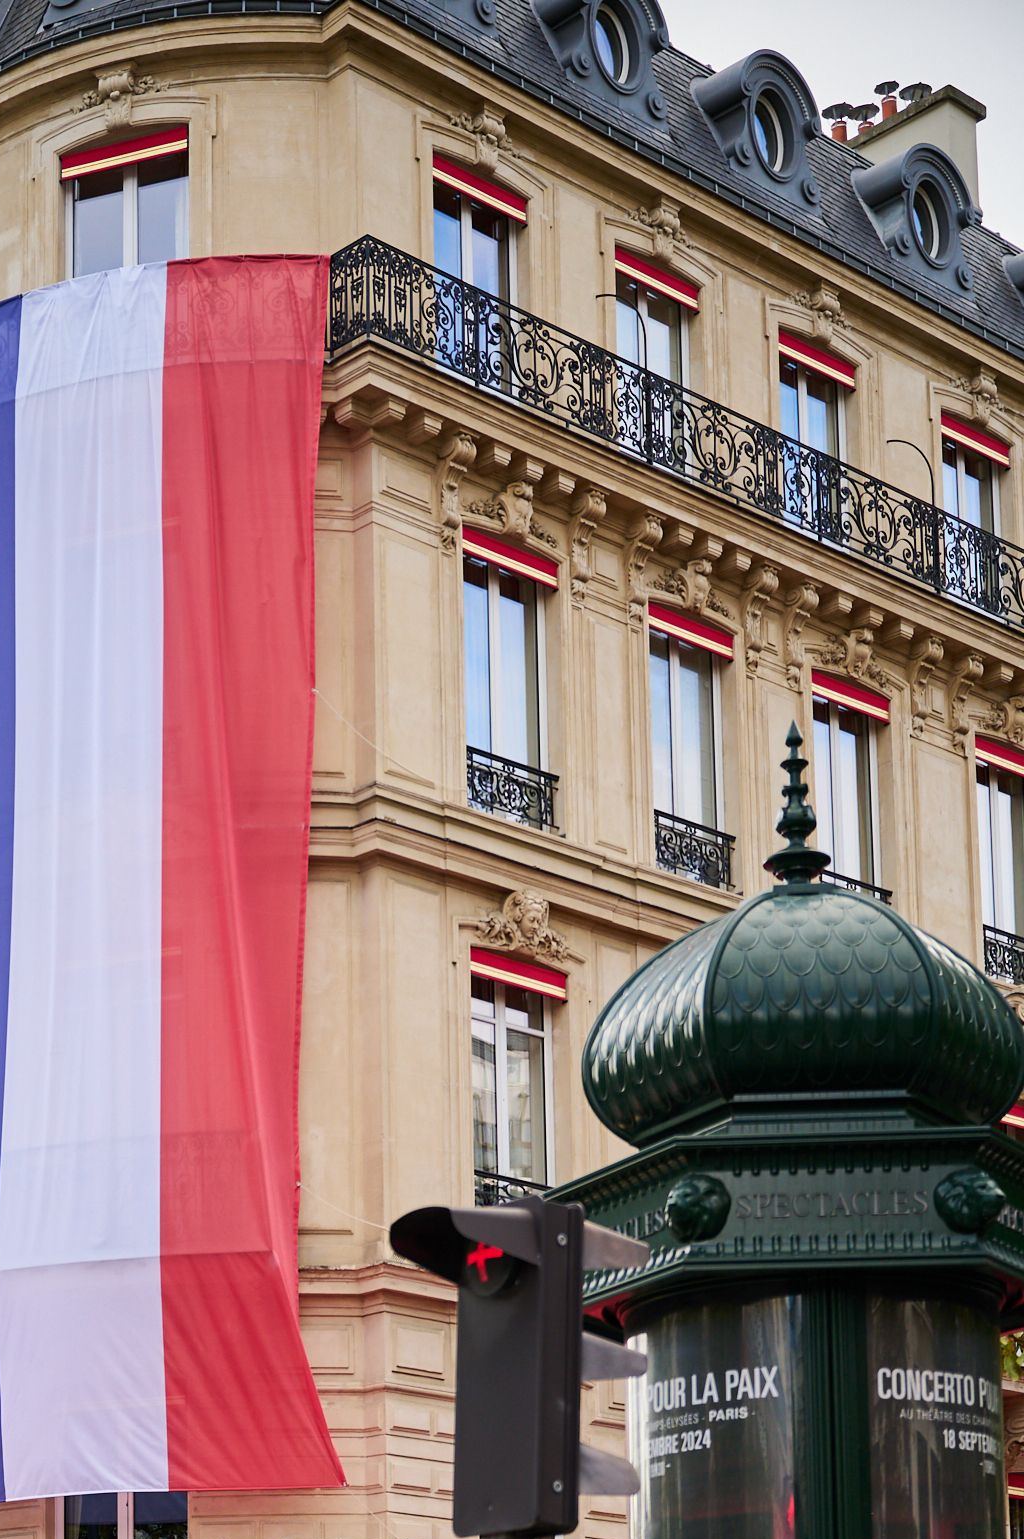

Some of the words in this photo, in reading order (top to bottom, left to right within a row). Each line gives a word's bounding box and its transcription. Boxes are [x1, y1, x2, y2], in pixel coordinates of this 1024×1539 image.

[735, 1190, 929, 1221] SPECTACLES
[691, 1372, 719, 1406] LA
[726, 1365, 779, 1402] PAIX
[877, 1367, 975, 1406] CONCERTO
[708, 1406, 749, 1422] PARIS
[899, 1408, 914, 1420] AU
[956, 1412, 972, 1425] DES
[681, 1428, 712, 1452] 2024
[943, 1428, 955, 1449] 18
